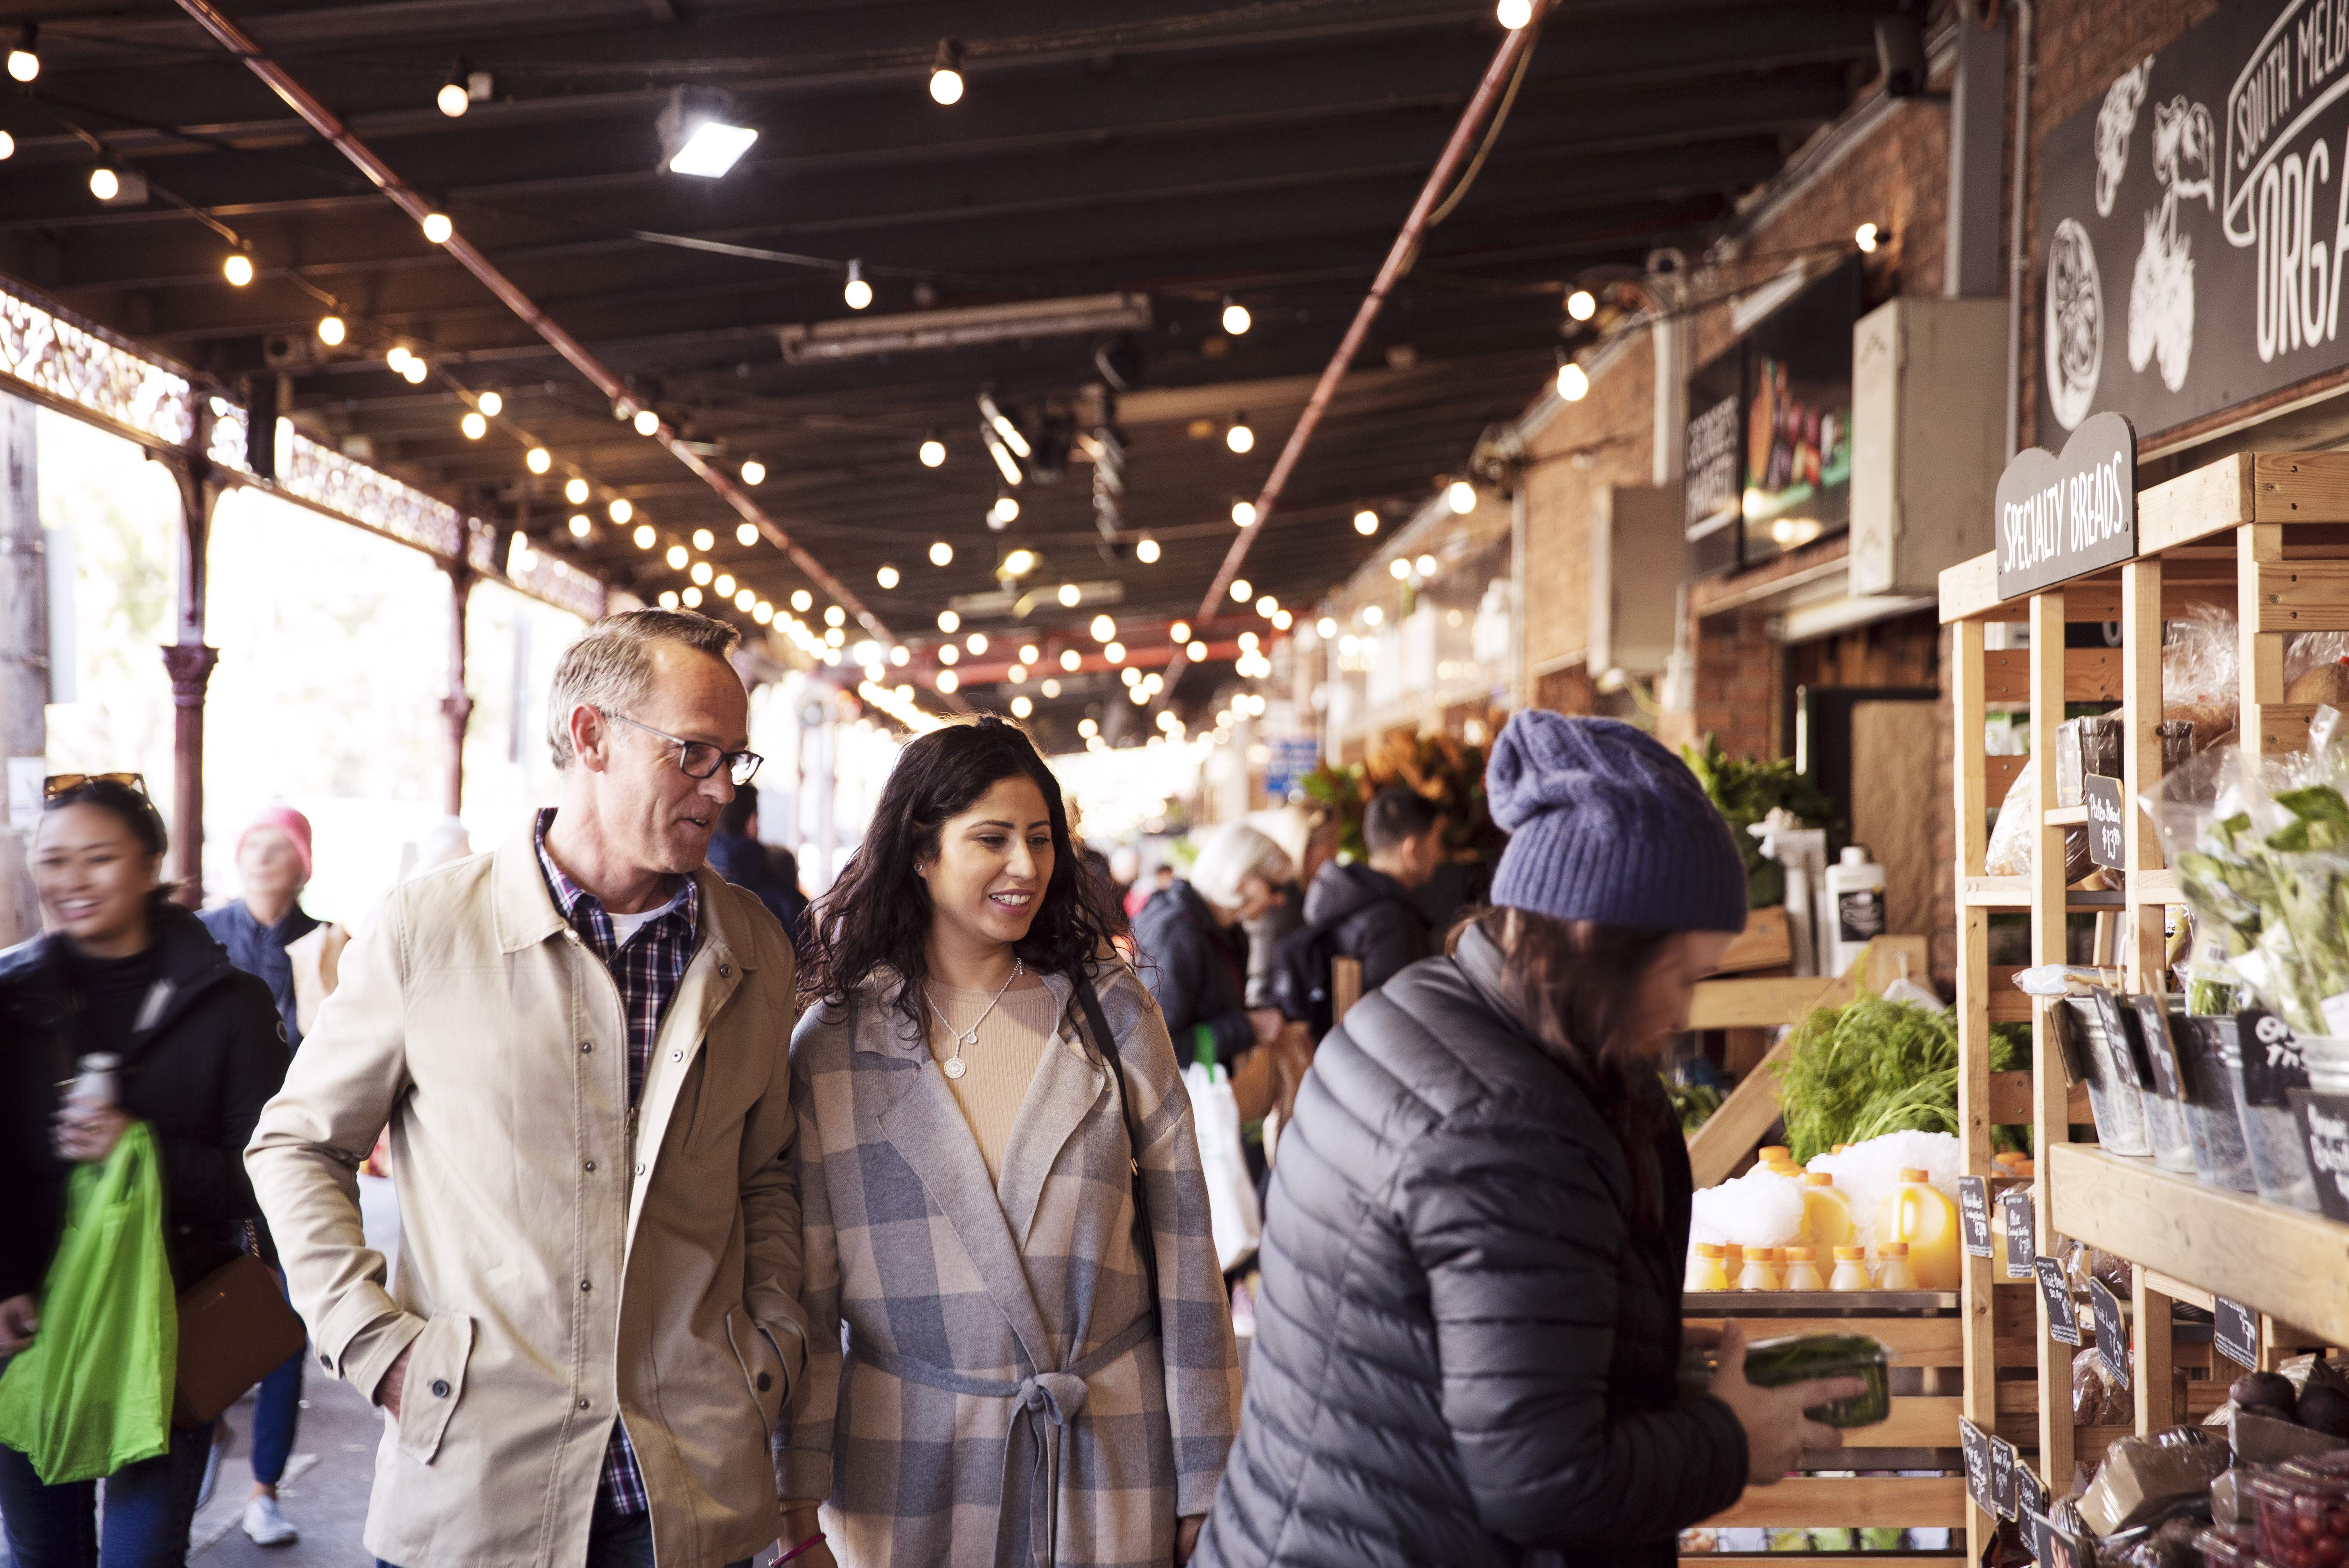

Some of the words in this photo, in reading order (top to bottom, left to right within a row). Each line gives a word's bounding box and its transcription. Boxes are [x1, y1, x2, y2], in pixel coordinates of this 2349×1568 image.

[2237, 33, 2290, 171] SOUTH
[2298, 0, 2349, 100] MELB
[2004, 478, 2065, 573] SPECIALTY
[2070, 451, 2122, 552] BREADS
[2089, 793, 2106, 822] Paleo
[2106, 799, 2120, 824] Bread
[2041, 1269, 2055, 1288] Fruit
[2092, 1297, 2106, 1325] Fruit
[2105, 1311, 2117, 1338] Loaf
[2002, 1452, 2012, 1474] Rye
